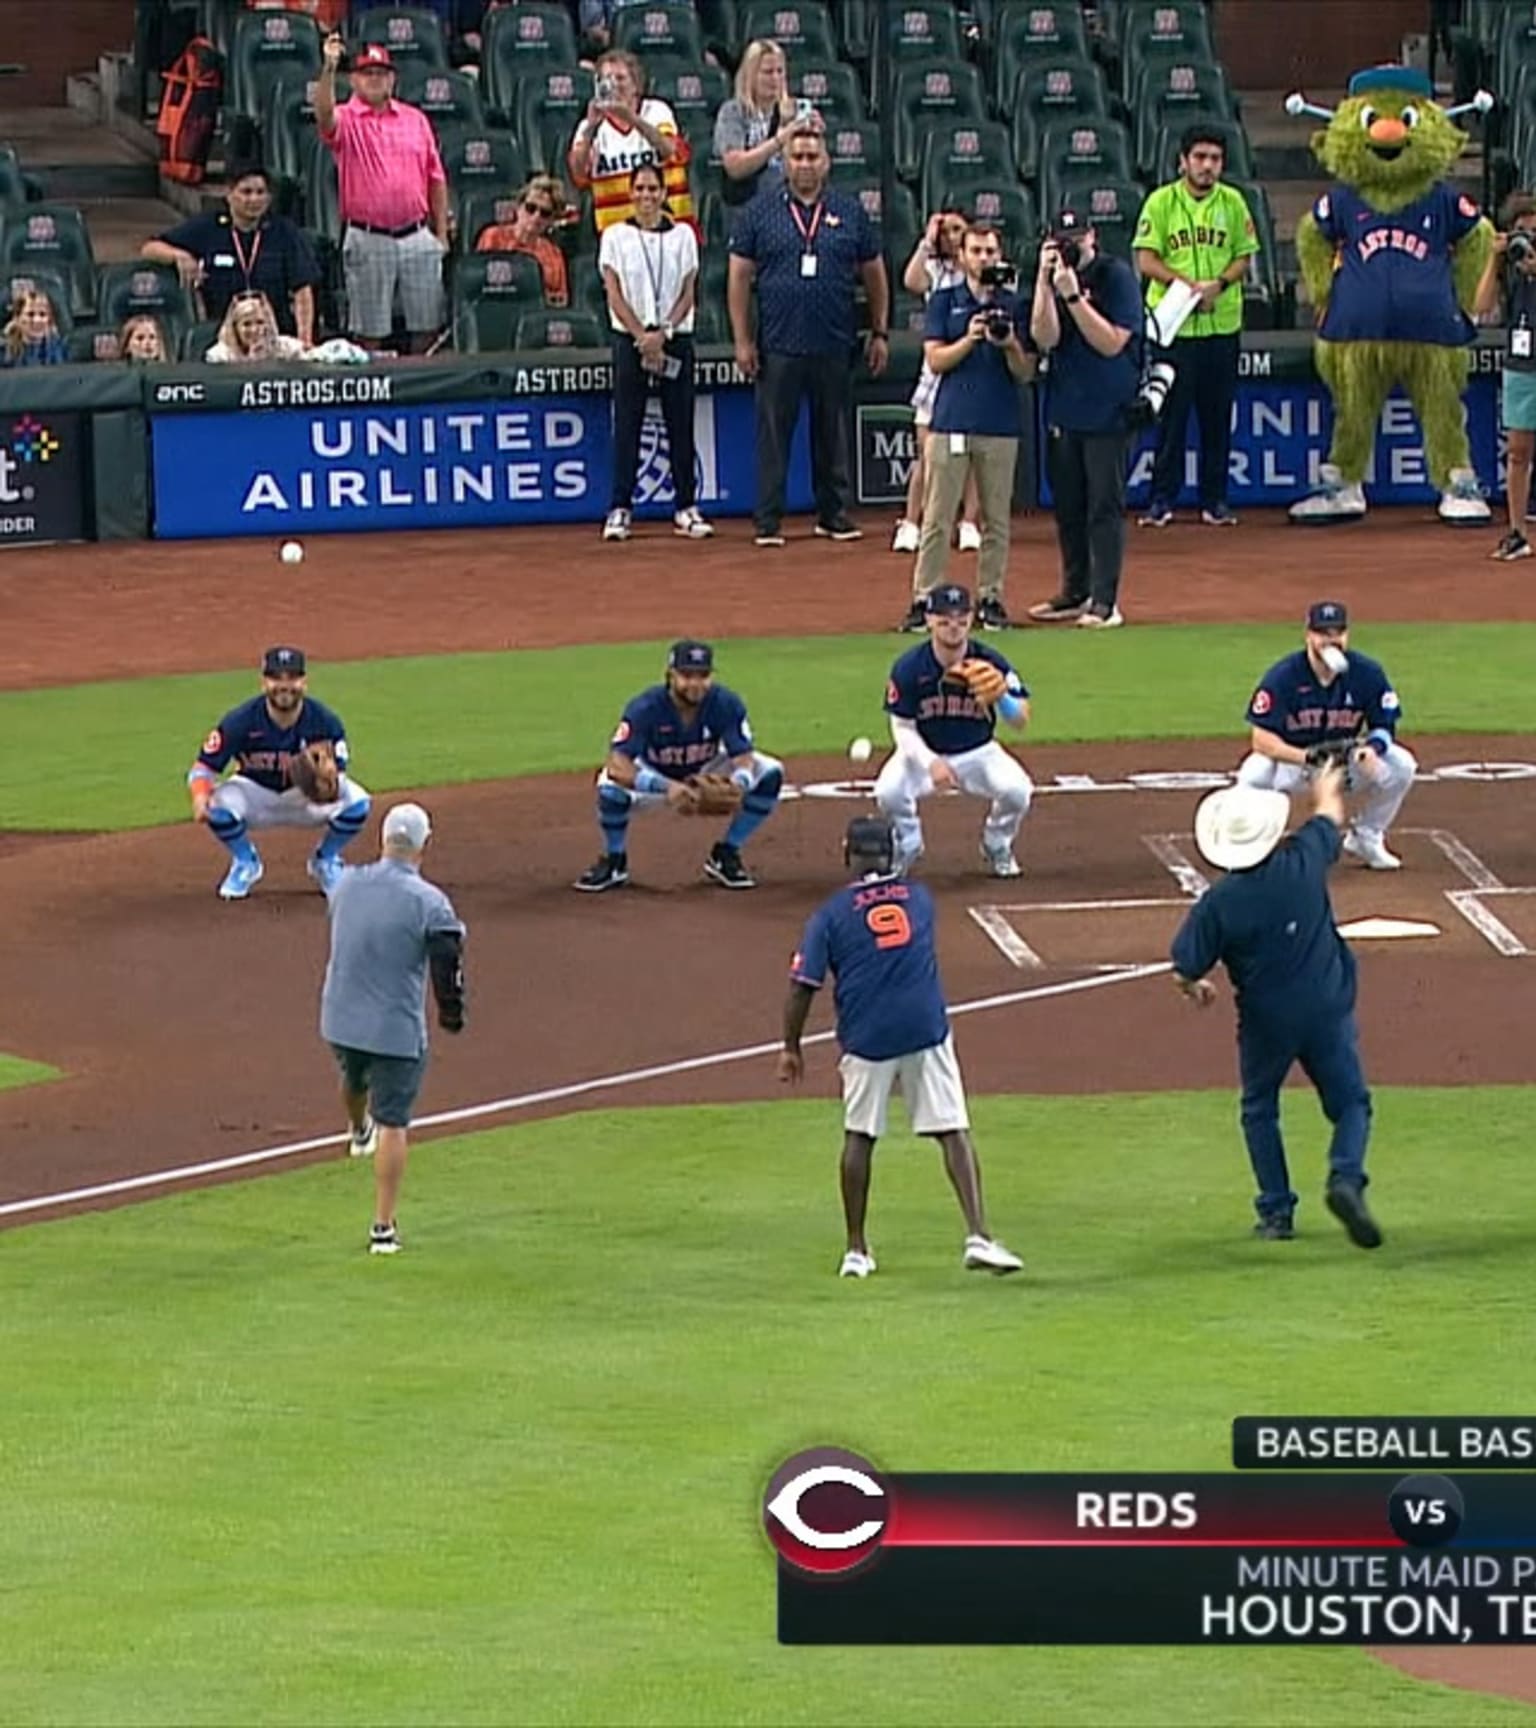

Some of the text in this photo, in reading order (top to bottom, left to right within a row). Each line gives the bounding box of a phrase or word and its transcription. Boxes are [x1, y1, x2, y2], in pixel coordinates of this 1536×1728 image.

[1168, 225, 1228, 254] ORBIT
[1357, 228, 1430, 263] ASTROS
[241, 376, 392, 406] ASTROS.COM
[311, 411, 586, 458] UNITED
[242, 460, 588, 512] AIRLINES
[866, 903, 912, 950] 9
